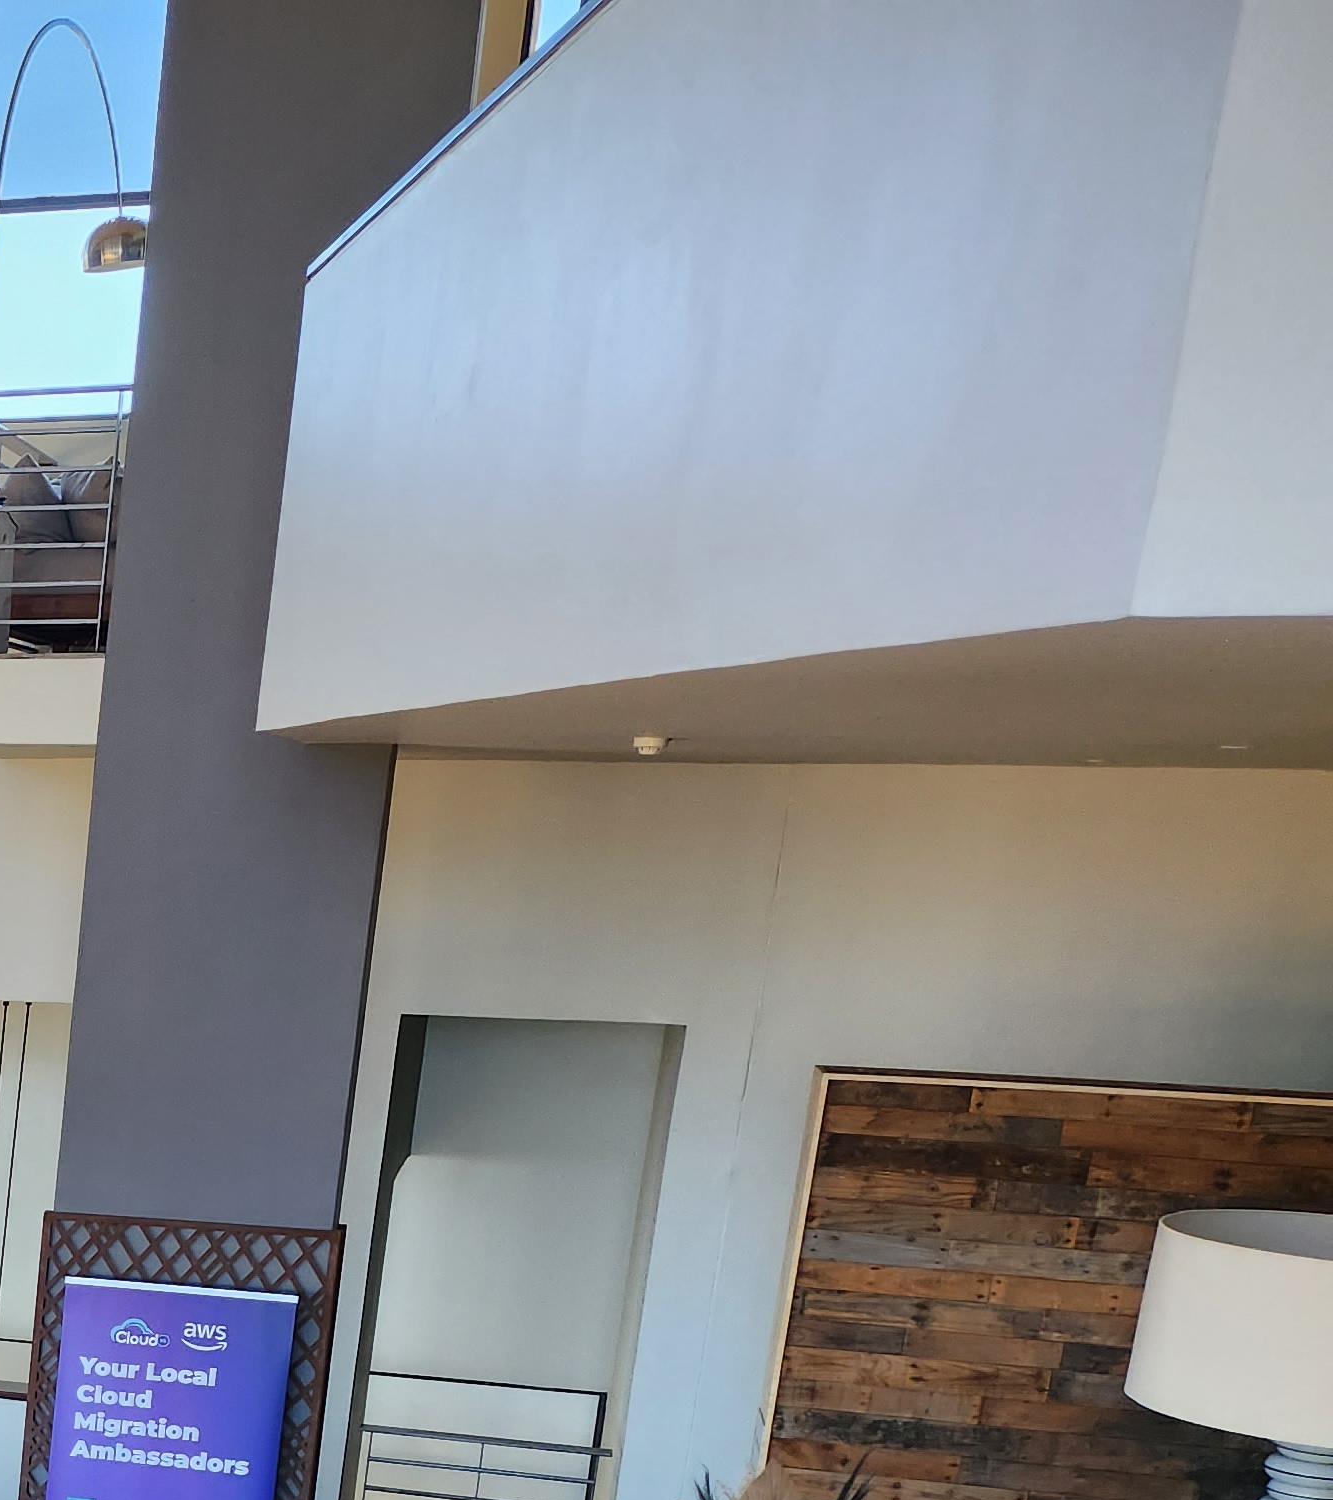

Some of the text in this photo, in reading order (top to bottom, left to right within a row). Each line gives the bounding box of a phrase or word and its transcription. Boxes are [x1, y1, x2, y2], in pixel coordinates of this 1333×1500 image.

[115, 1330, 159, 1347] Cloud
[183, 1322, 228, 1341] aws
[80, 1356, 217, 1387] Your Local
[76, 1384, 153, 1409] Cloud
[74, 1411, 200, 1442] Migration
[69, 1439, 249, 1476] Ambassadors
